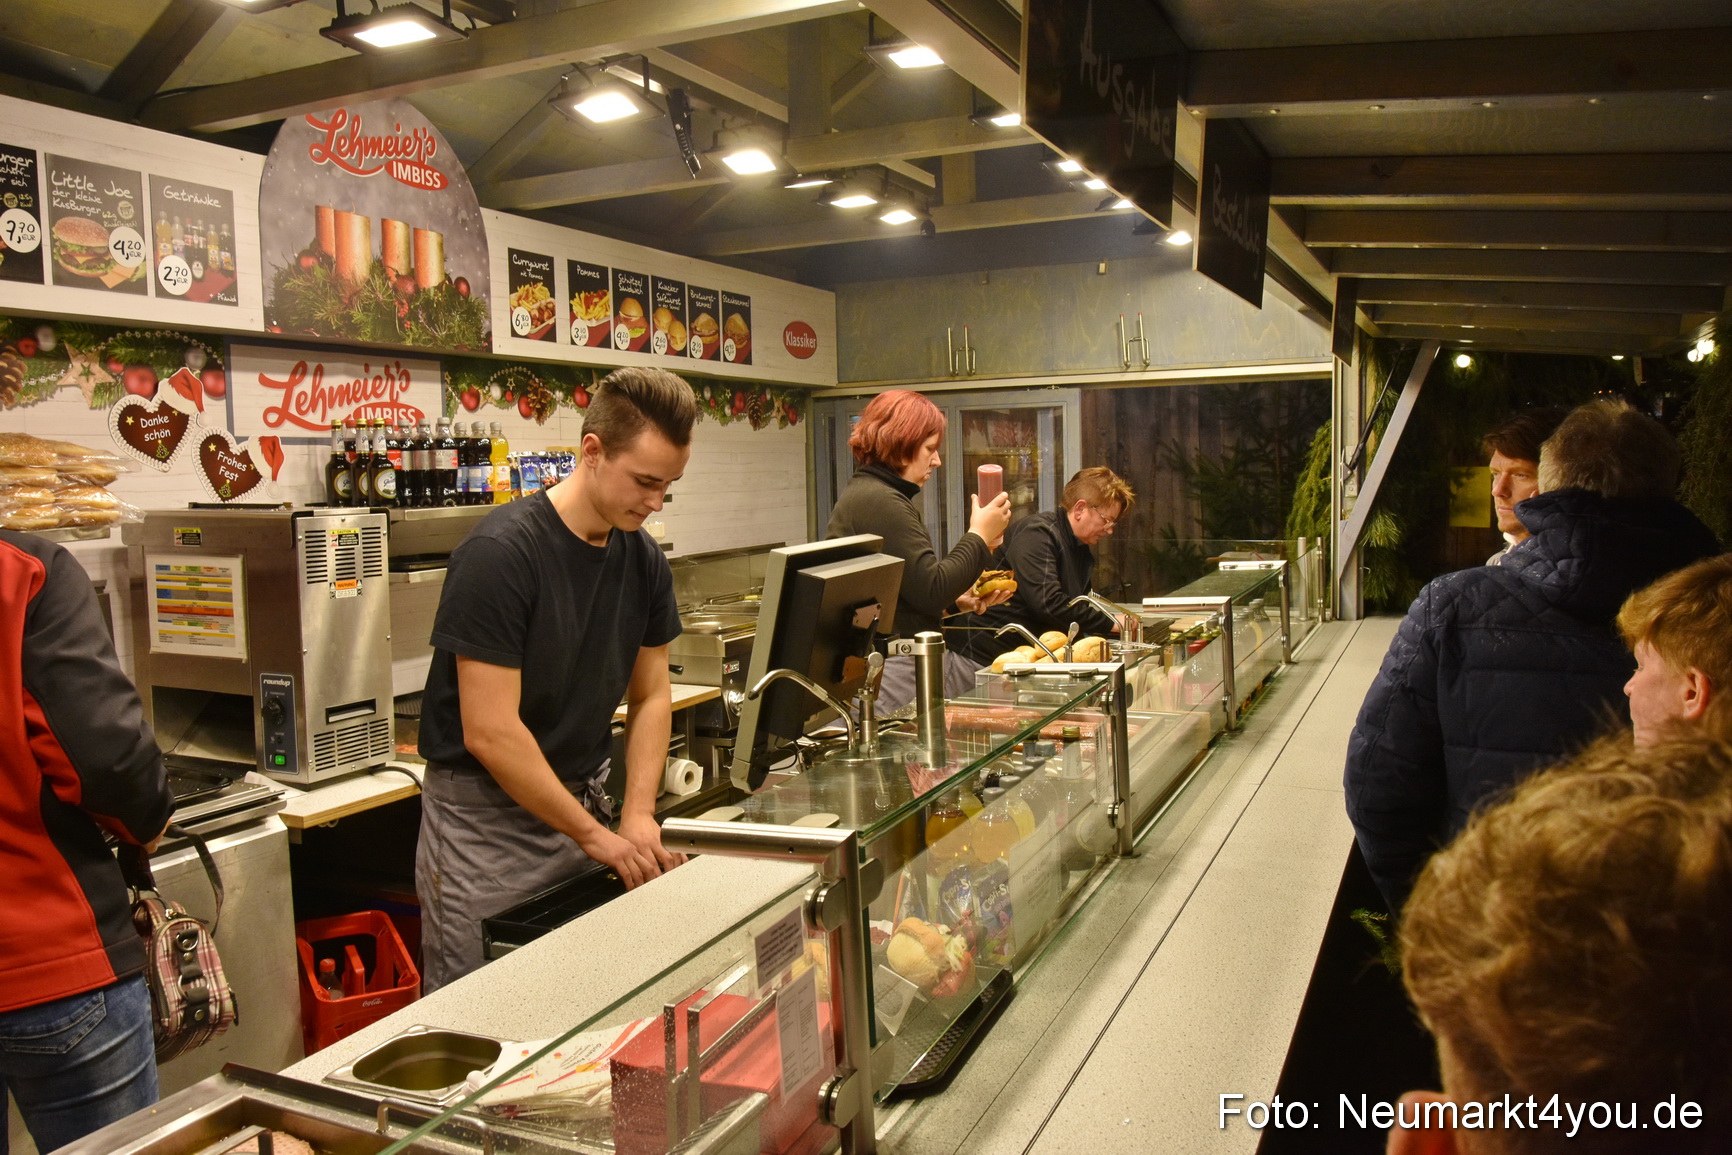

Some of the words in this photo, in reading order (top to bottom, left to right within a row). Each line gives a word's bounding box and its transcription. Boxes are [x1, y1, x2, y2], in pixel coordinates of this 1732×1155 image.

[305, 108, 438, 177] Lehmeier's
[392, 161, 441, 188] IMBISS
[51, 170, 97, 192] Little
[104, 180, 133, 199] Joe
[52, 187, 70, 198] der
[75, 190, 102, 204] kleine
[6, 220, 35, 244] 7,70
[113, 240, 141, 260] 4,20
[512, 254, 550, 271] Currywurst
[577, 265, 600, 279] Pommes
[163, 266, 188, 286] 2,70
[786, 331, 817, 349] Klassiker
[258, 360, 411, 431] Lehmeier's
[140, 416, 169, 428] Danke
[144, 429, 171, 441] schön
[217, 451, 247, 472] Frohes
[219, 466, 239, 481] Fest
[263, 679, 291, 687] roundup
